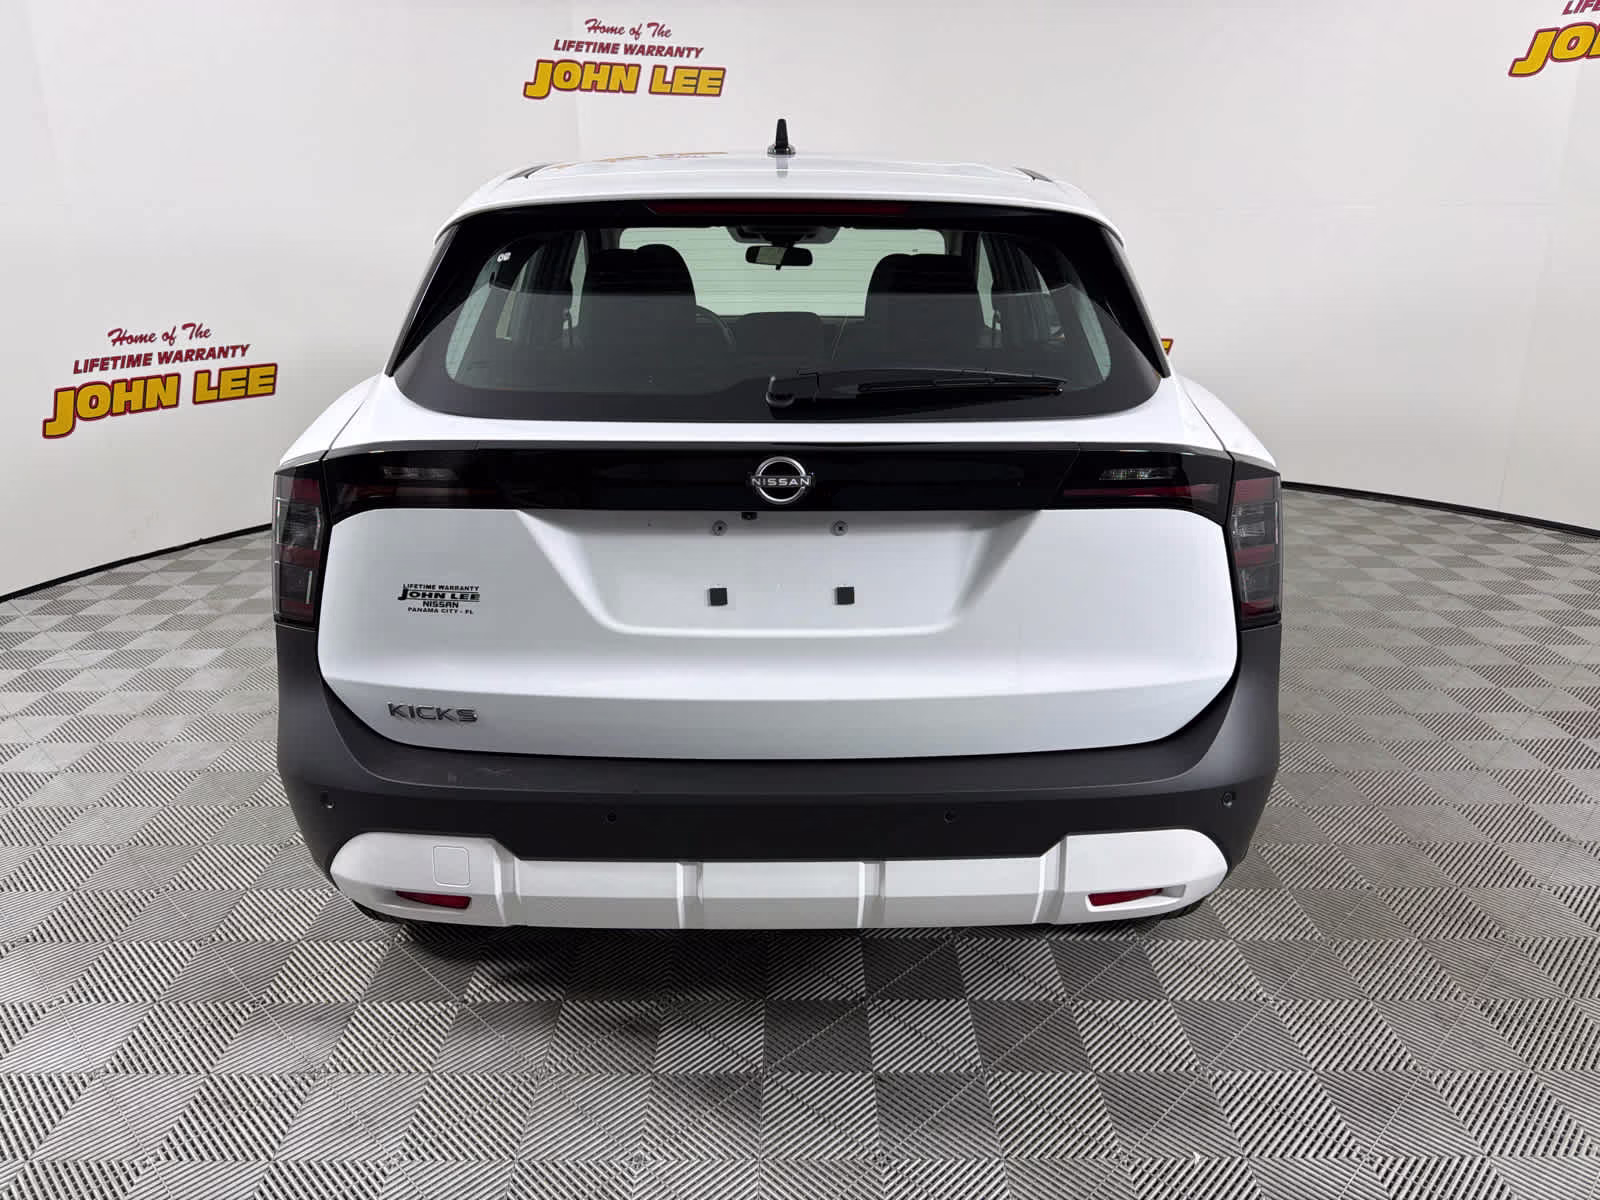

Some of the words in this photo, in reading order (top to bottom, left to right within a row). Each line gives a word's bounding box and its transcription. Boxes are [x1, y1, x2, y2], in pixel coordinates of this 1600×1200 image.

[584, 18, 625, 35] Home
[629, 24, 642, 40] of
[647, 22, 672, 38] The
[553, 39, 619, 55] LIFETIME
[623, 43, 704, 59] WARRANTY
[523, 59, 641, 99] JOHN
[648, 65, 726, 96] LEE
[107, 328, 157, 346] Home
[161, 326, 176, 346] of
[181, 323, 211, 340] The
[73, 352, 153, 374] LIFETIME
[157, 344, 250, 365] WARRANTY
[42, 373, 181, 439] JOHN
[192, 363, 278, 405] LEE
[751, 478, 810, 486] NISSAN
[398, 588, 446, 601] JOHN
[450, 593, 480, 601] LEE
[422, 600, 459, 608] NISSAN
[387, 702, 478, 722] KICKS
